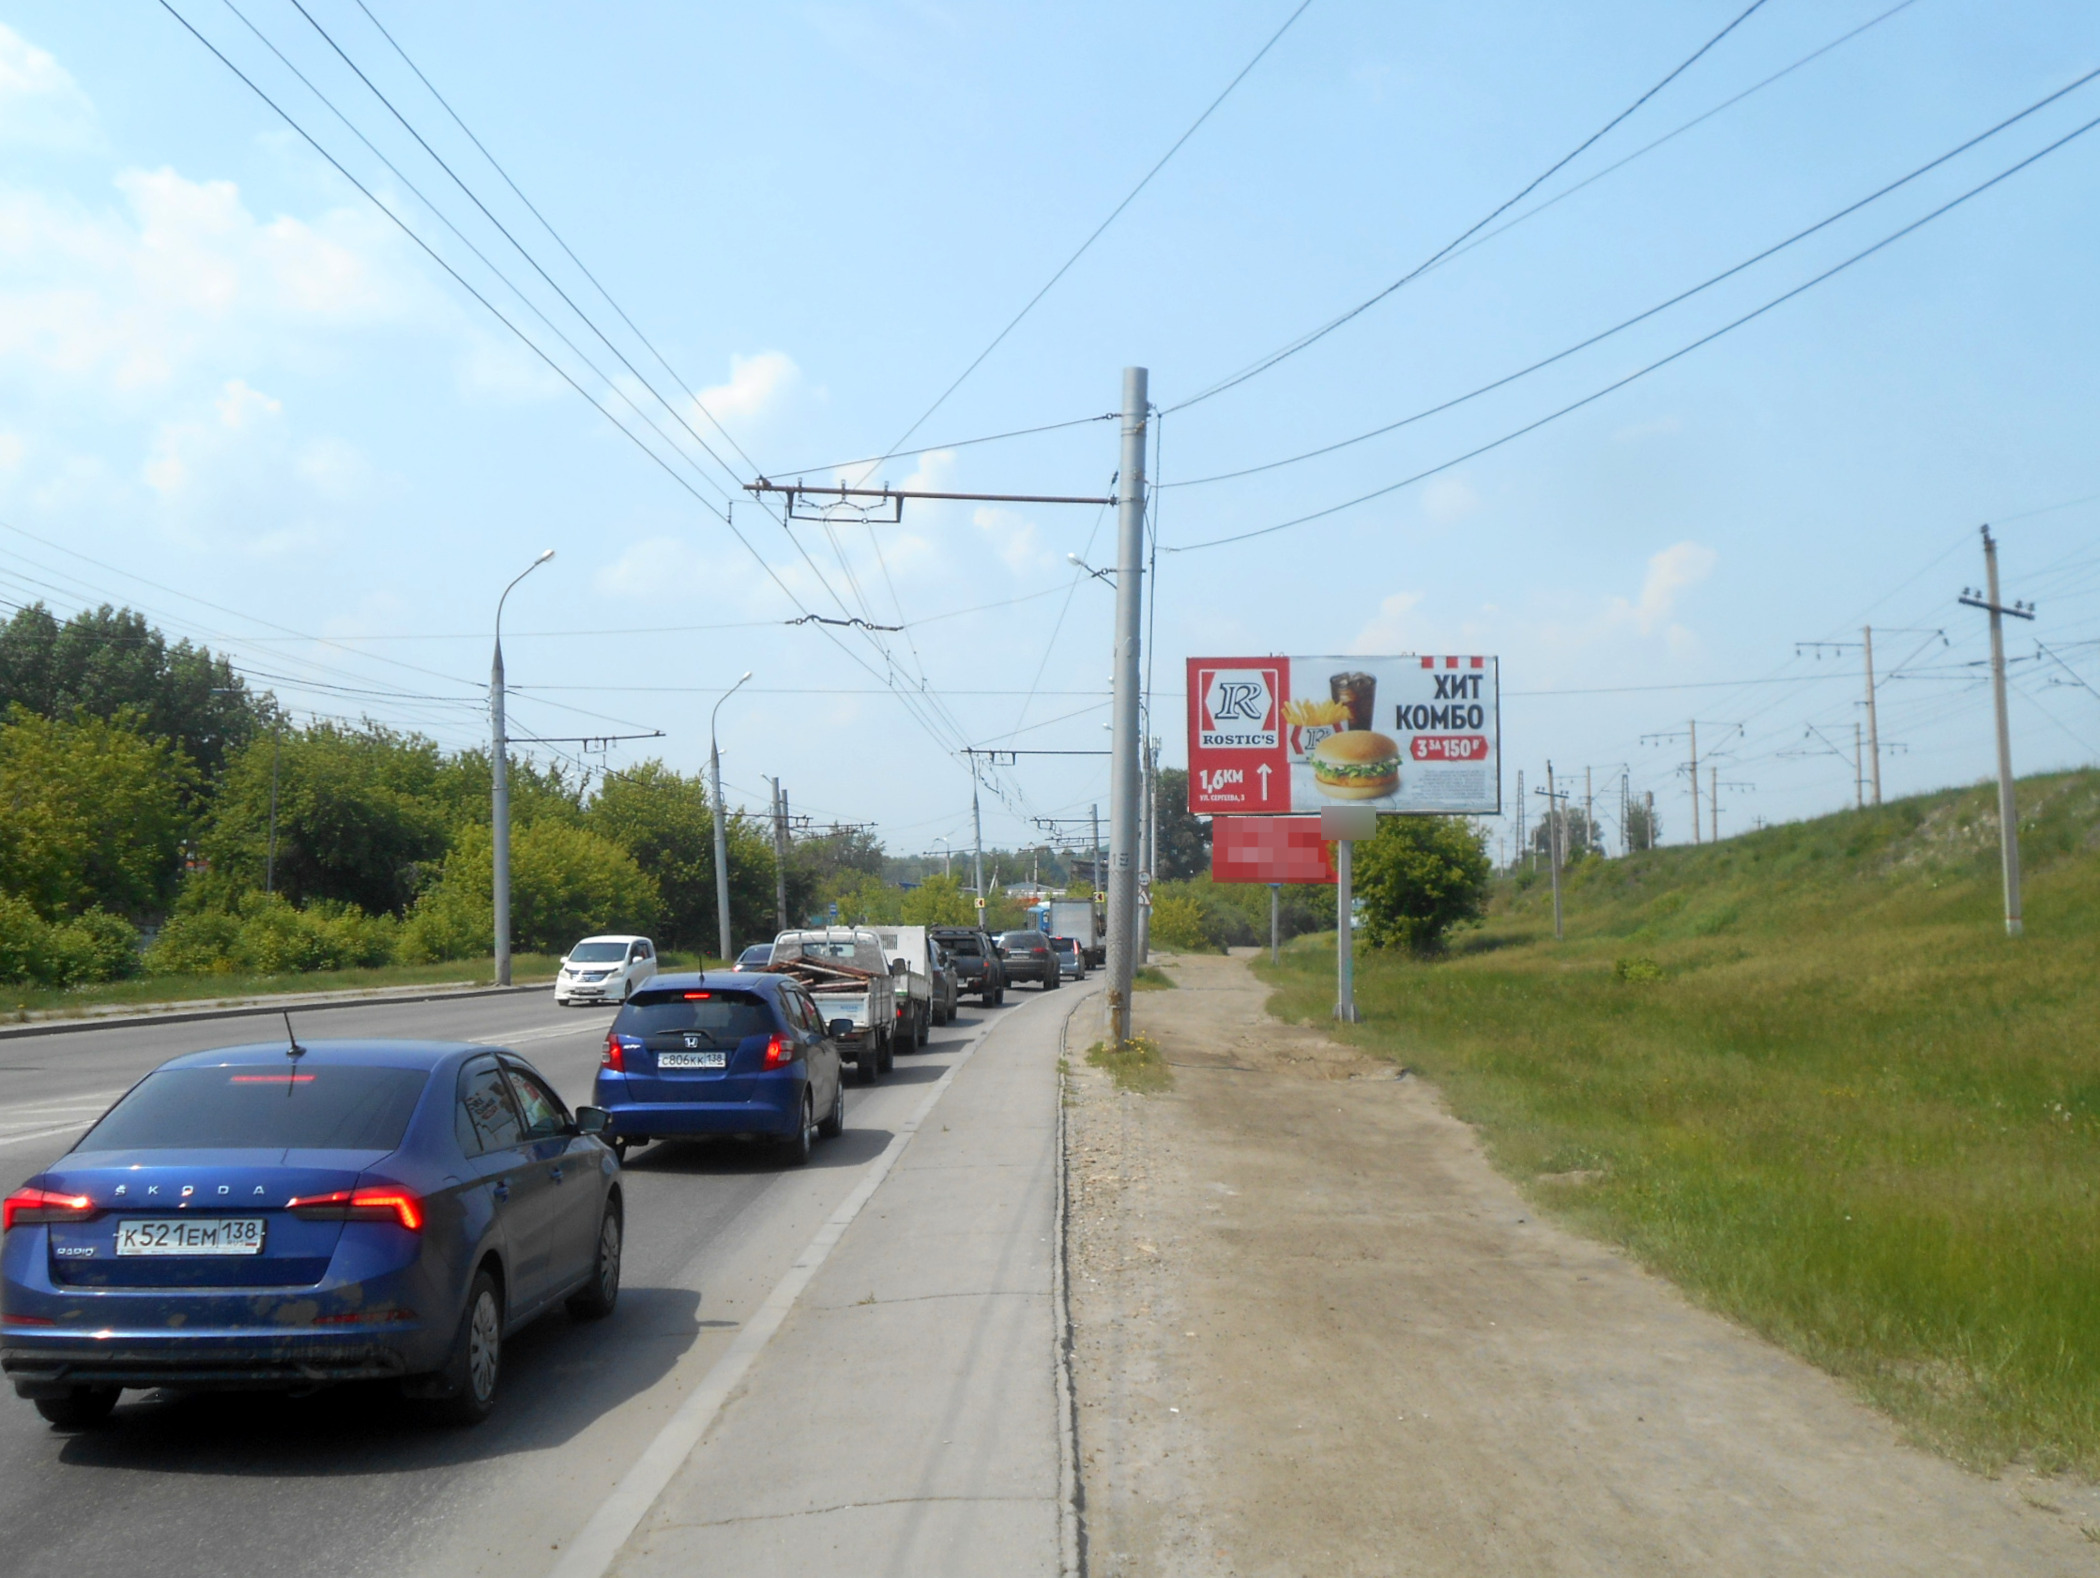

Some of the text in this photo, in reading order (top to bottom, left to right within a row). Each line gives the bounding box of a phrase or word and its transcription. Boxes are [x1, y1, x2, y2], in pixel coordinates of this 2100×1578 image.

[1434, 674, 1484, 700] ХИТ
[1214, 682, 1262, 720] R
[1396, 704, 1484, 730] КОМБО
[1202, 734, 1275, 745] ROSTIC'S
[1417, 739, 1428, 757] 3
[124, 1222, 256, 1247] К521ЕМ 138
